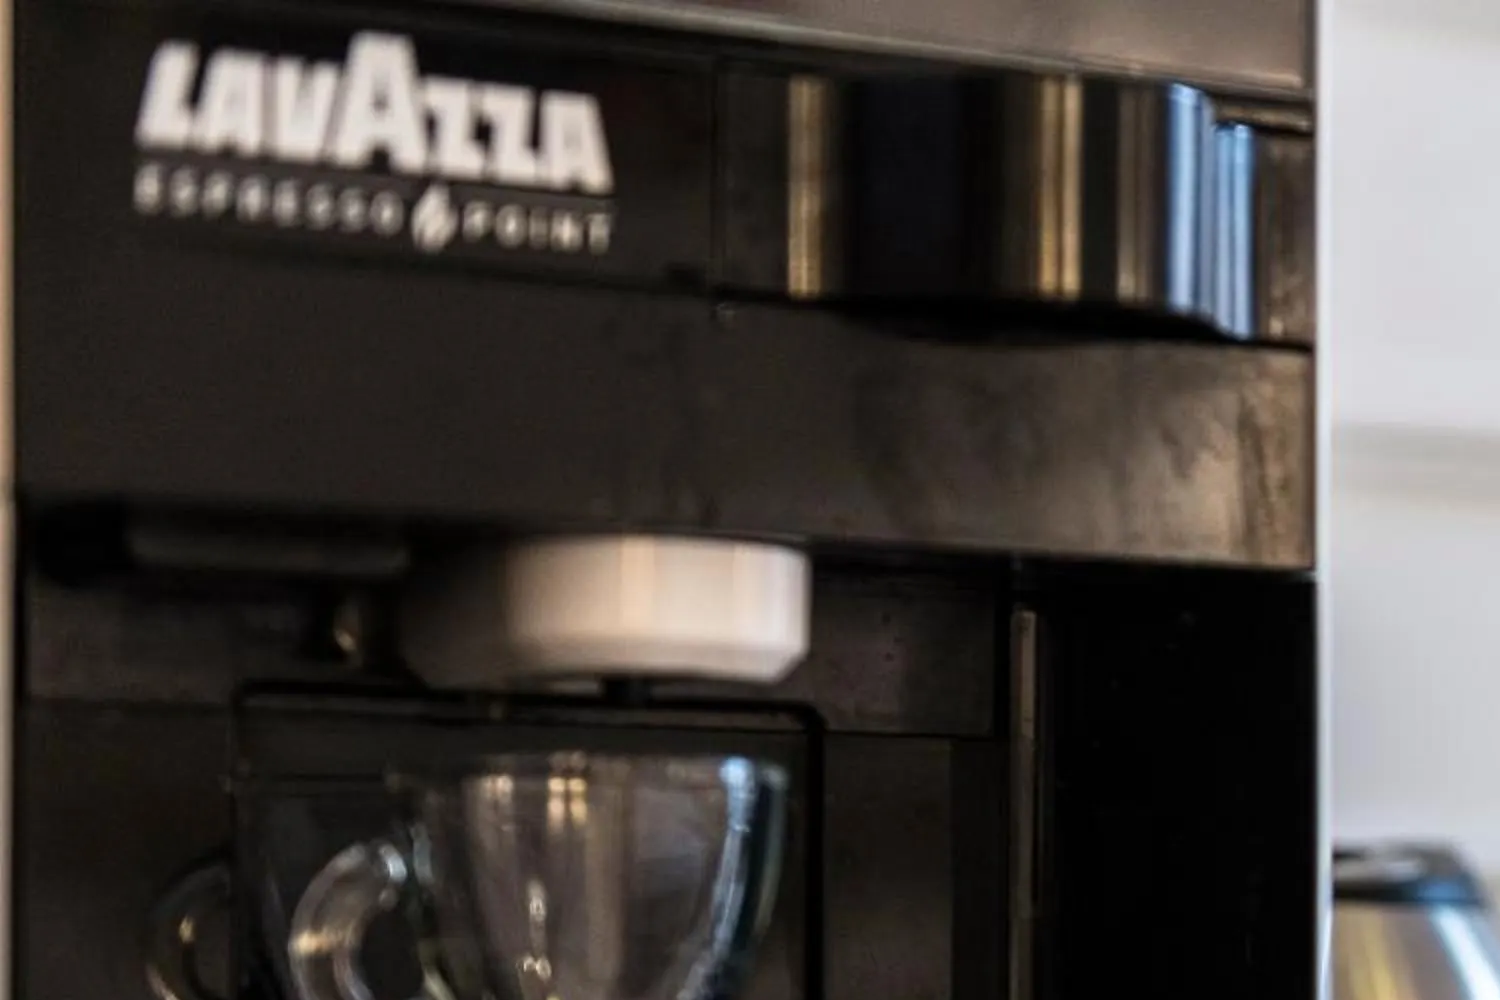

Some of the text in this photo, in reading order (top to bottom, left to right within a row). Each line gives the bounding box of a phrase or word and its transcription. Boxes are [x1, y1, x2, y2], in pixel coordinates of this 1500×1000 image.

[135, 30, 613, 194] LAVAZZA
[134, 164, 612, 254] ESPRESSO POINT
